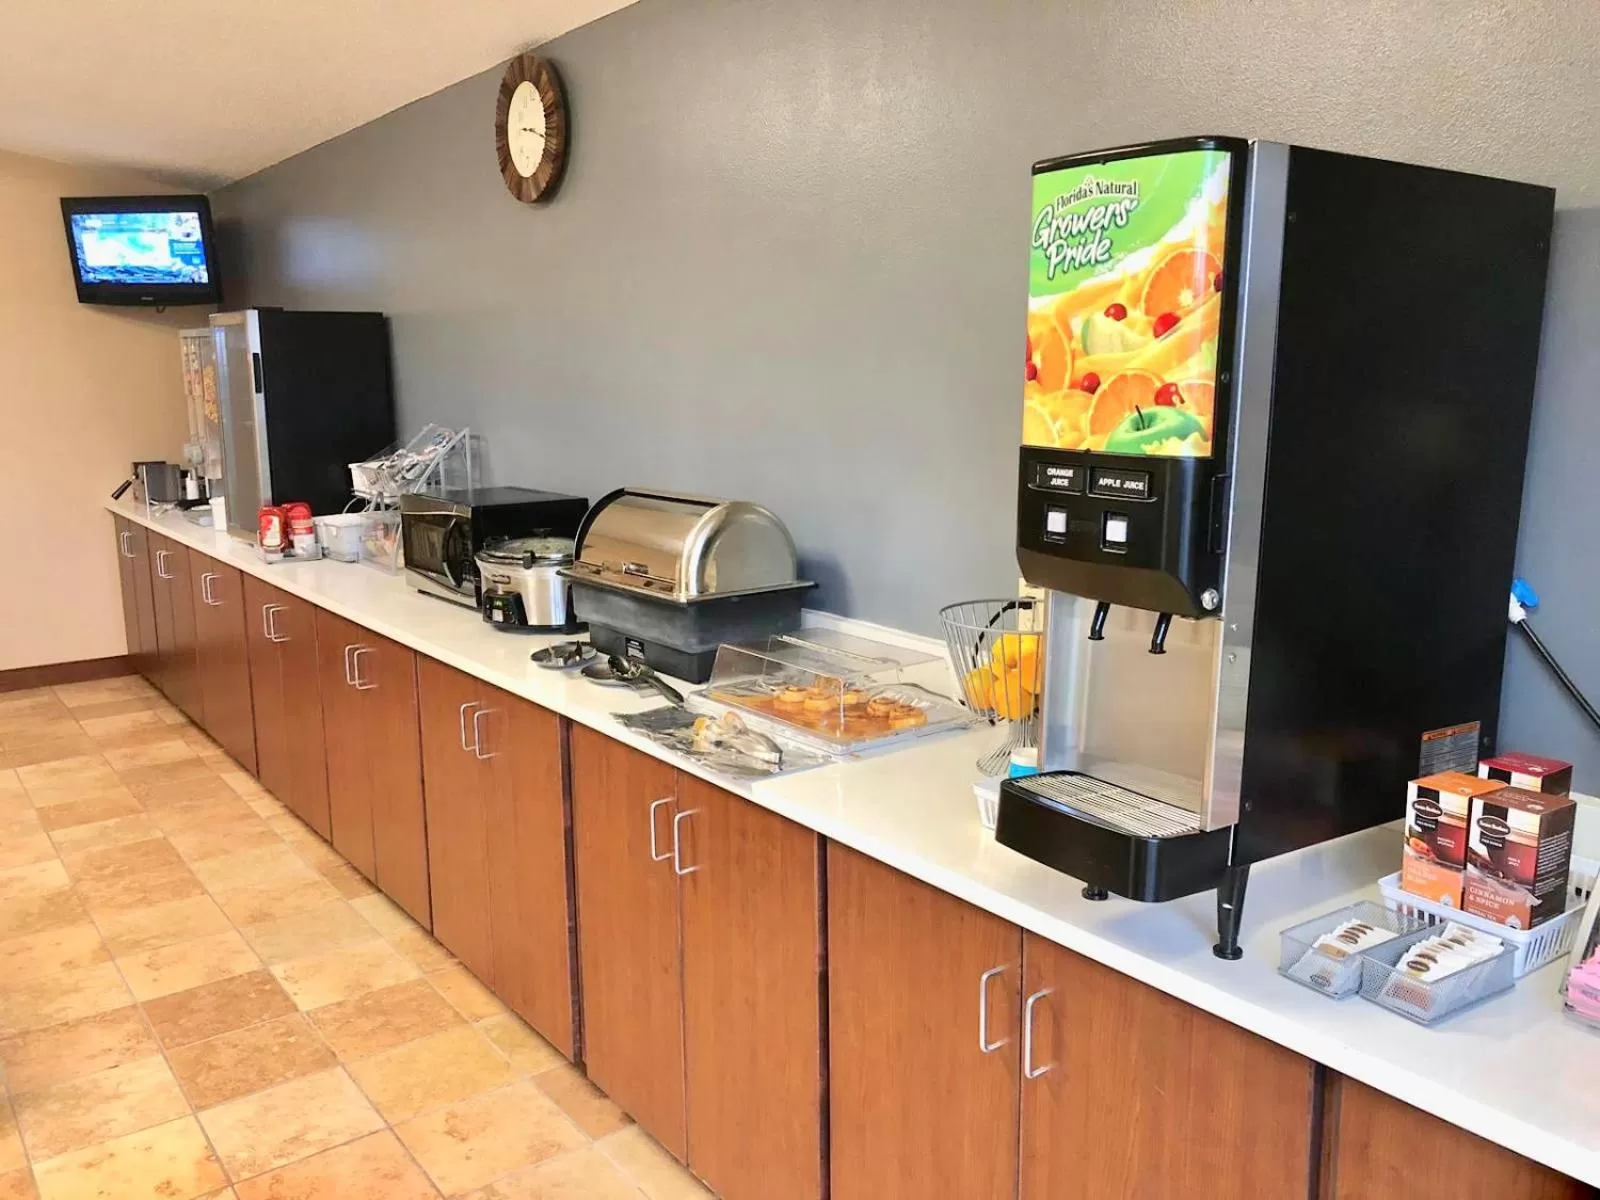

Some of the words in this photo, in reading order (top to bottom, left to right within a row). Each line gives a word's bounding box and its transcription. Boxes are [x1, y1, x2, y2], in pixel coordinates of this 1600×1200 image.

[1096, 181, 1137, 195] Natural
[1045, 227, 1113, 280] Pride
[1047, 468, 1074, 477] ORANGE
[1050, 478, 1069, 486] JUICE
[1099, 478, 1121, 488] APPLE
[1123, 481, 1144, 490] JUICE
[1469, 886, 1516, 906] CINNAMON
[1475, 896, 1500, 910] SPICE
